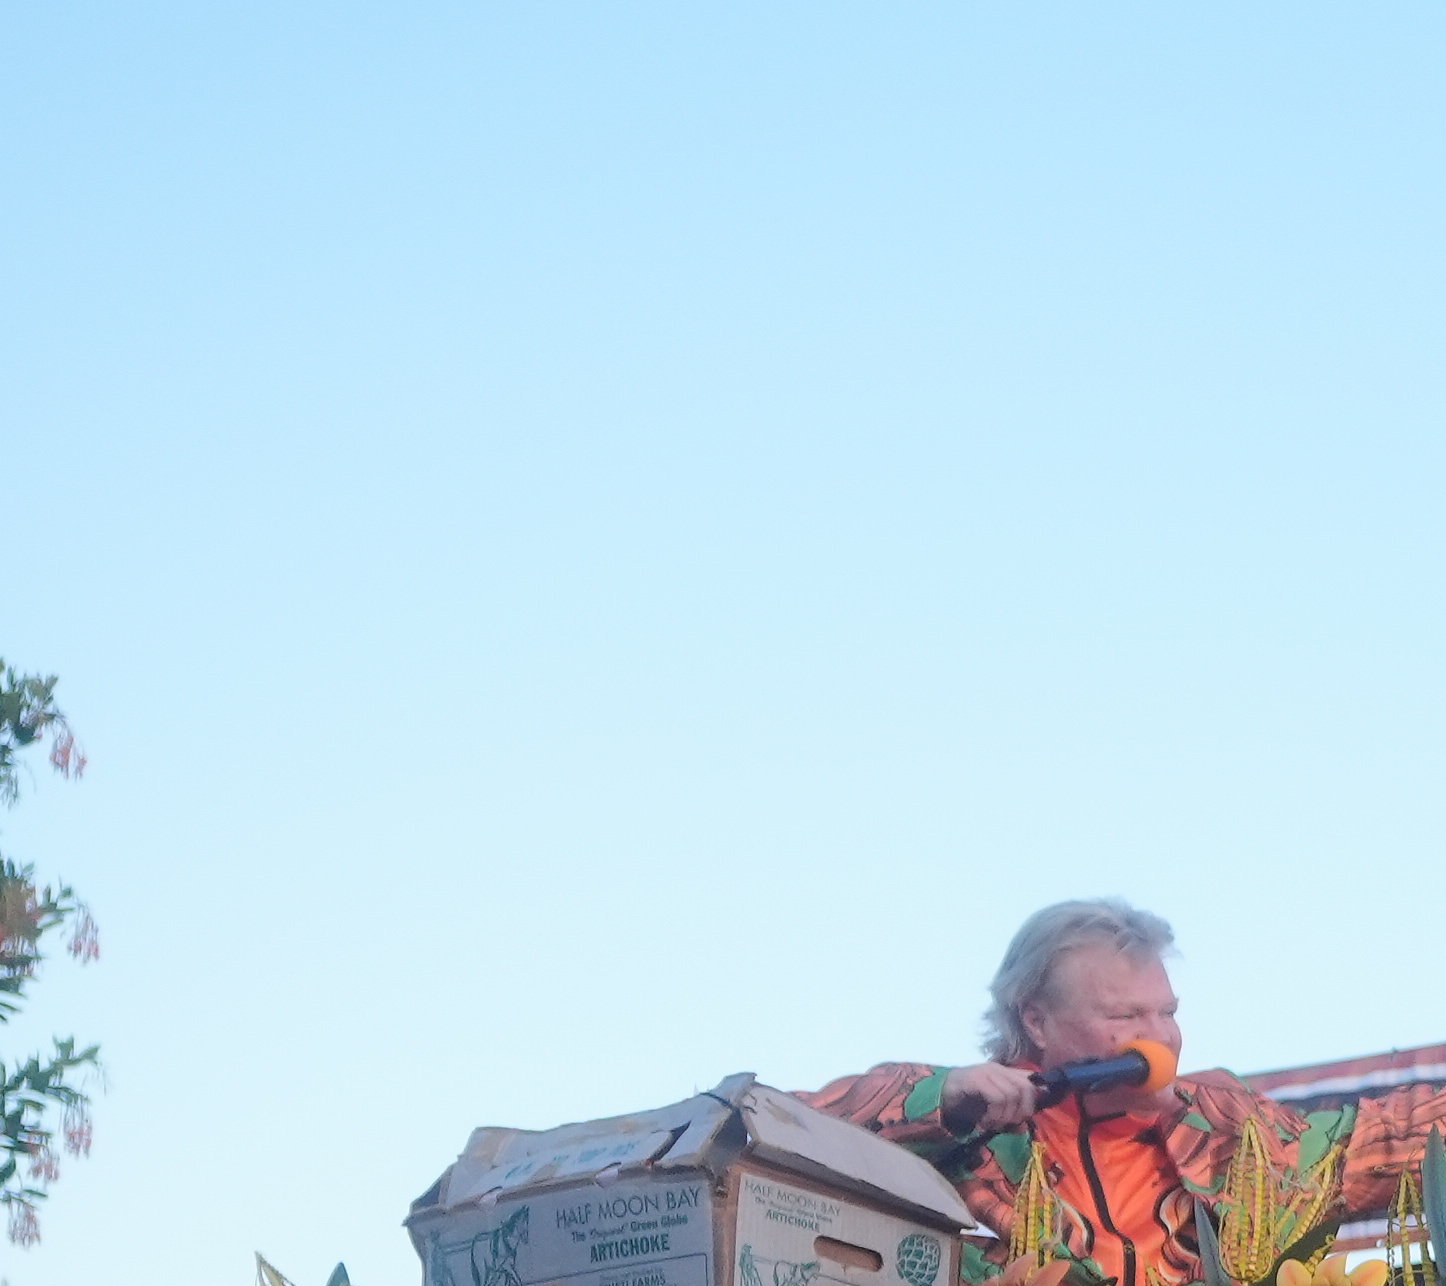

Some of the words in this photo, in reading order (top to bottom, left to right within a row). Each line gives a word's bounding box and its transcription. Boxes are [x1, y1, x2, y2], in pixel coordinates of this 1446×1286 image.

[556, 1202, 591, 1228] HALF
[598, 1194, 659, 1220] MOON
[666, 1185, 700, 1211] BAY
[776, 1189, 817, 1210] MOON
[820, 1201, 841, 1217] BAY
[765, 1209, 821, 1233] ARTICHOKE
[590, 1233, 670, 1264] ARTICHOKE
